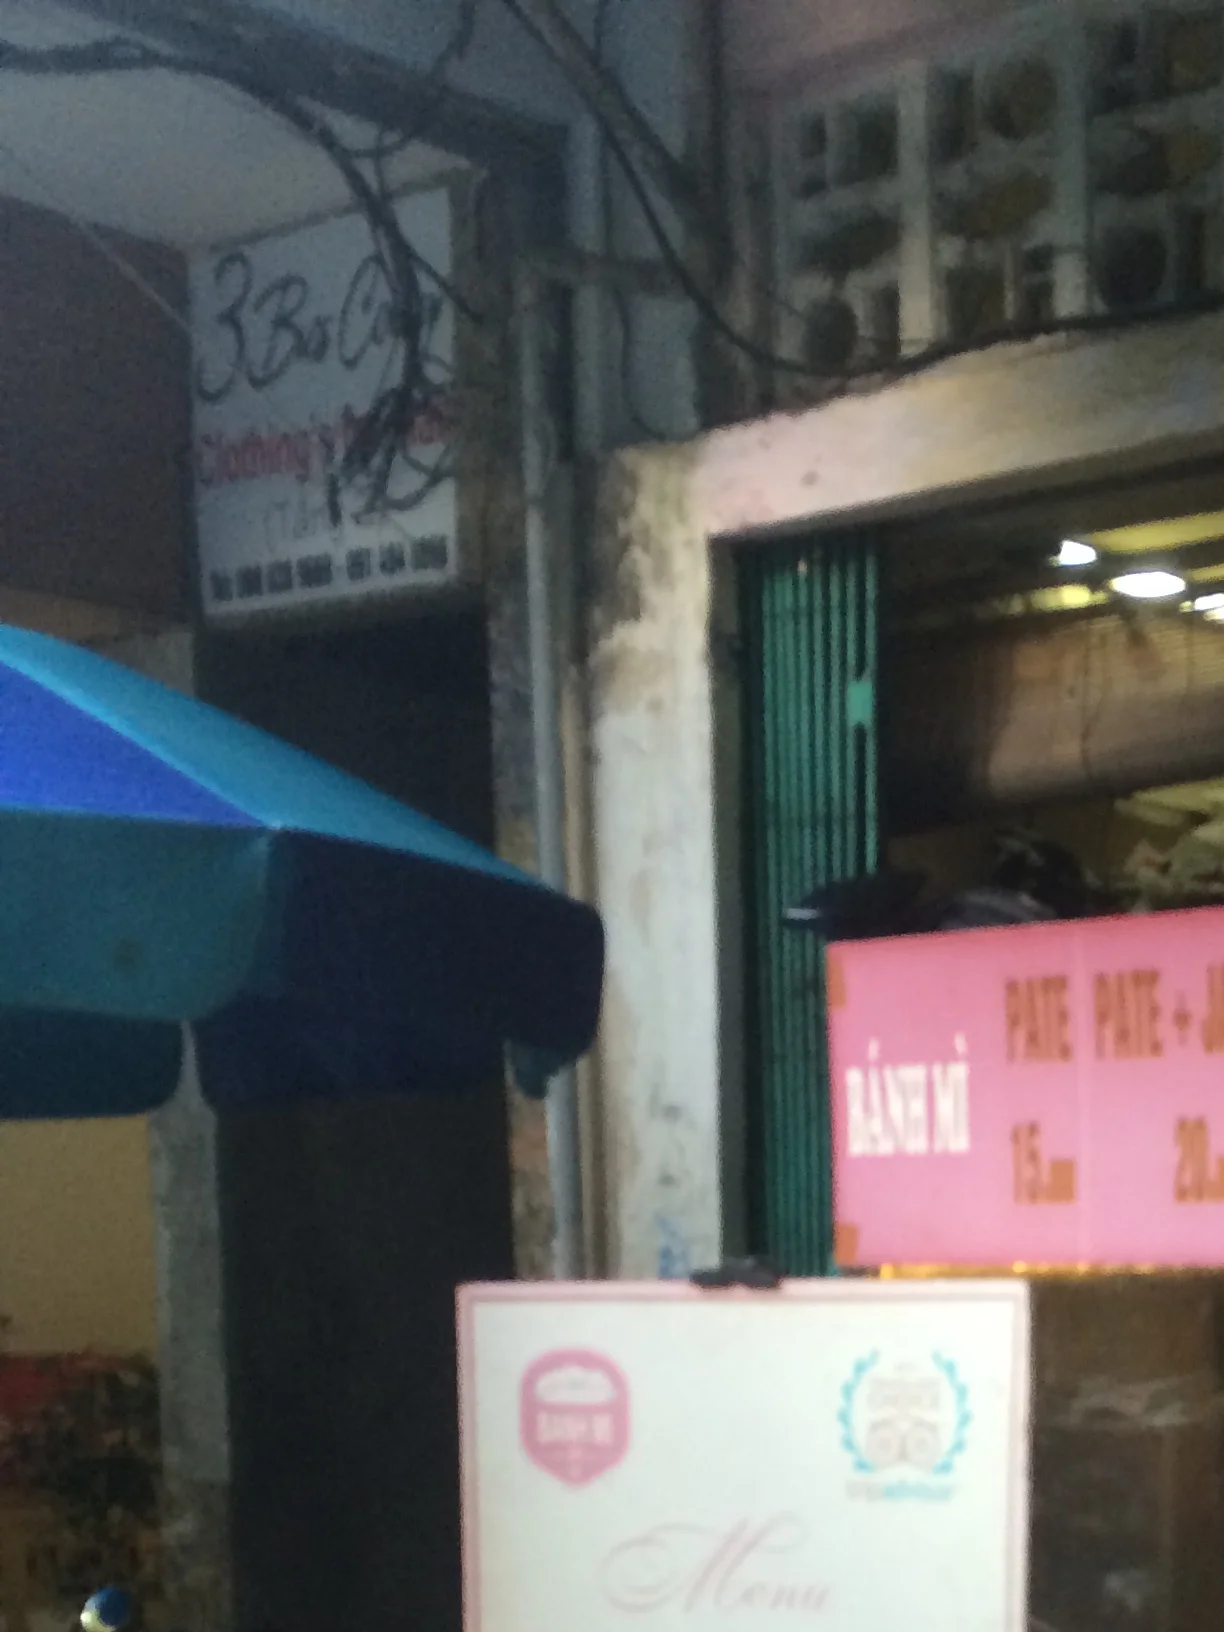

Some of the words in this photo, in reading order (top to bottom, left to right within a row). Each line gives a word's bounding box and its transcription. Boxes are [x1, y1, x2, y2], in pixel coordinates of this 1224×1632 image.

[1005, 976, 1072, 1065] PATE
[1093, 969, 1164, 1060] PATE
[599, 1510, 830, 1615] Menu
